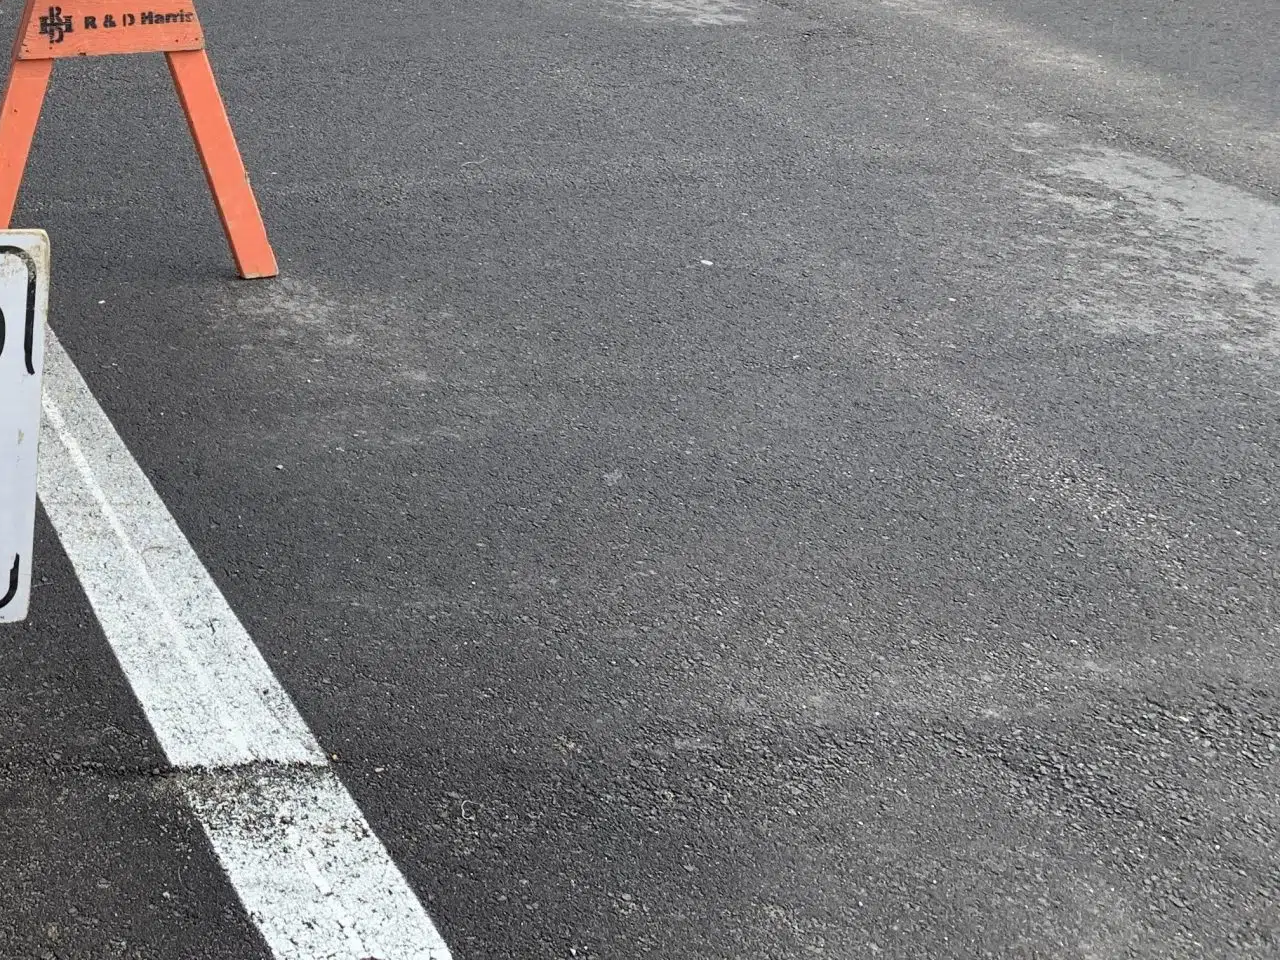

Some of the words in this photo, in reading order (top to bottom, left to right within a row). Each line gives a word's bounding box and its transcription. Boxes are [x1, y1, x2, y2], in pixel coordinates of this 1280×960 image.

[84, 15, 97, 29] R
[103, 14, 116, 28] &
[123, 13, 135, 26] D
[141, 9, 194, 25] Harris
